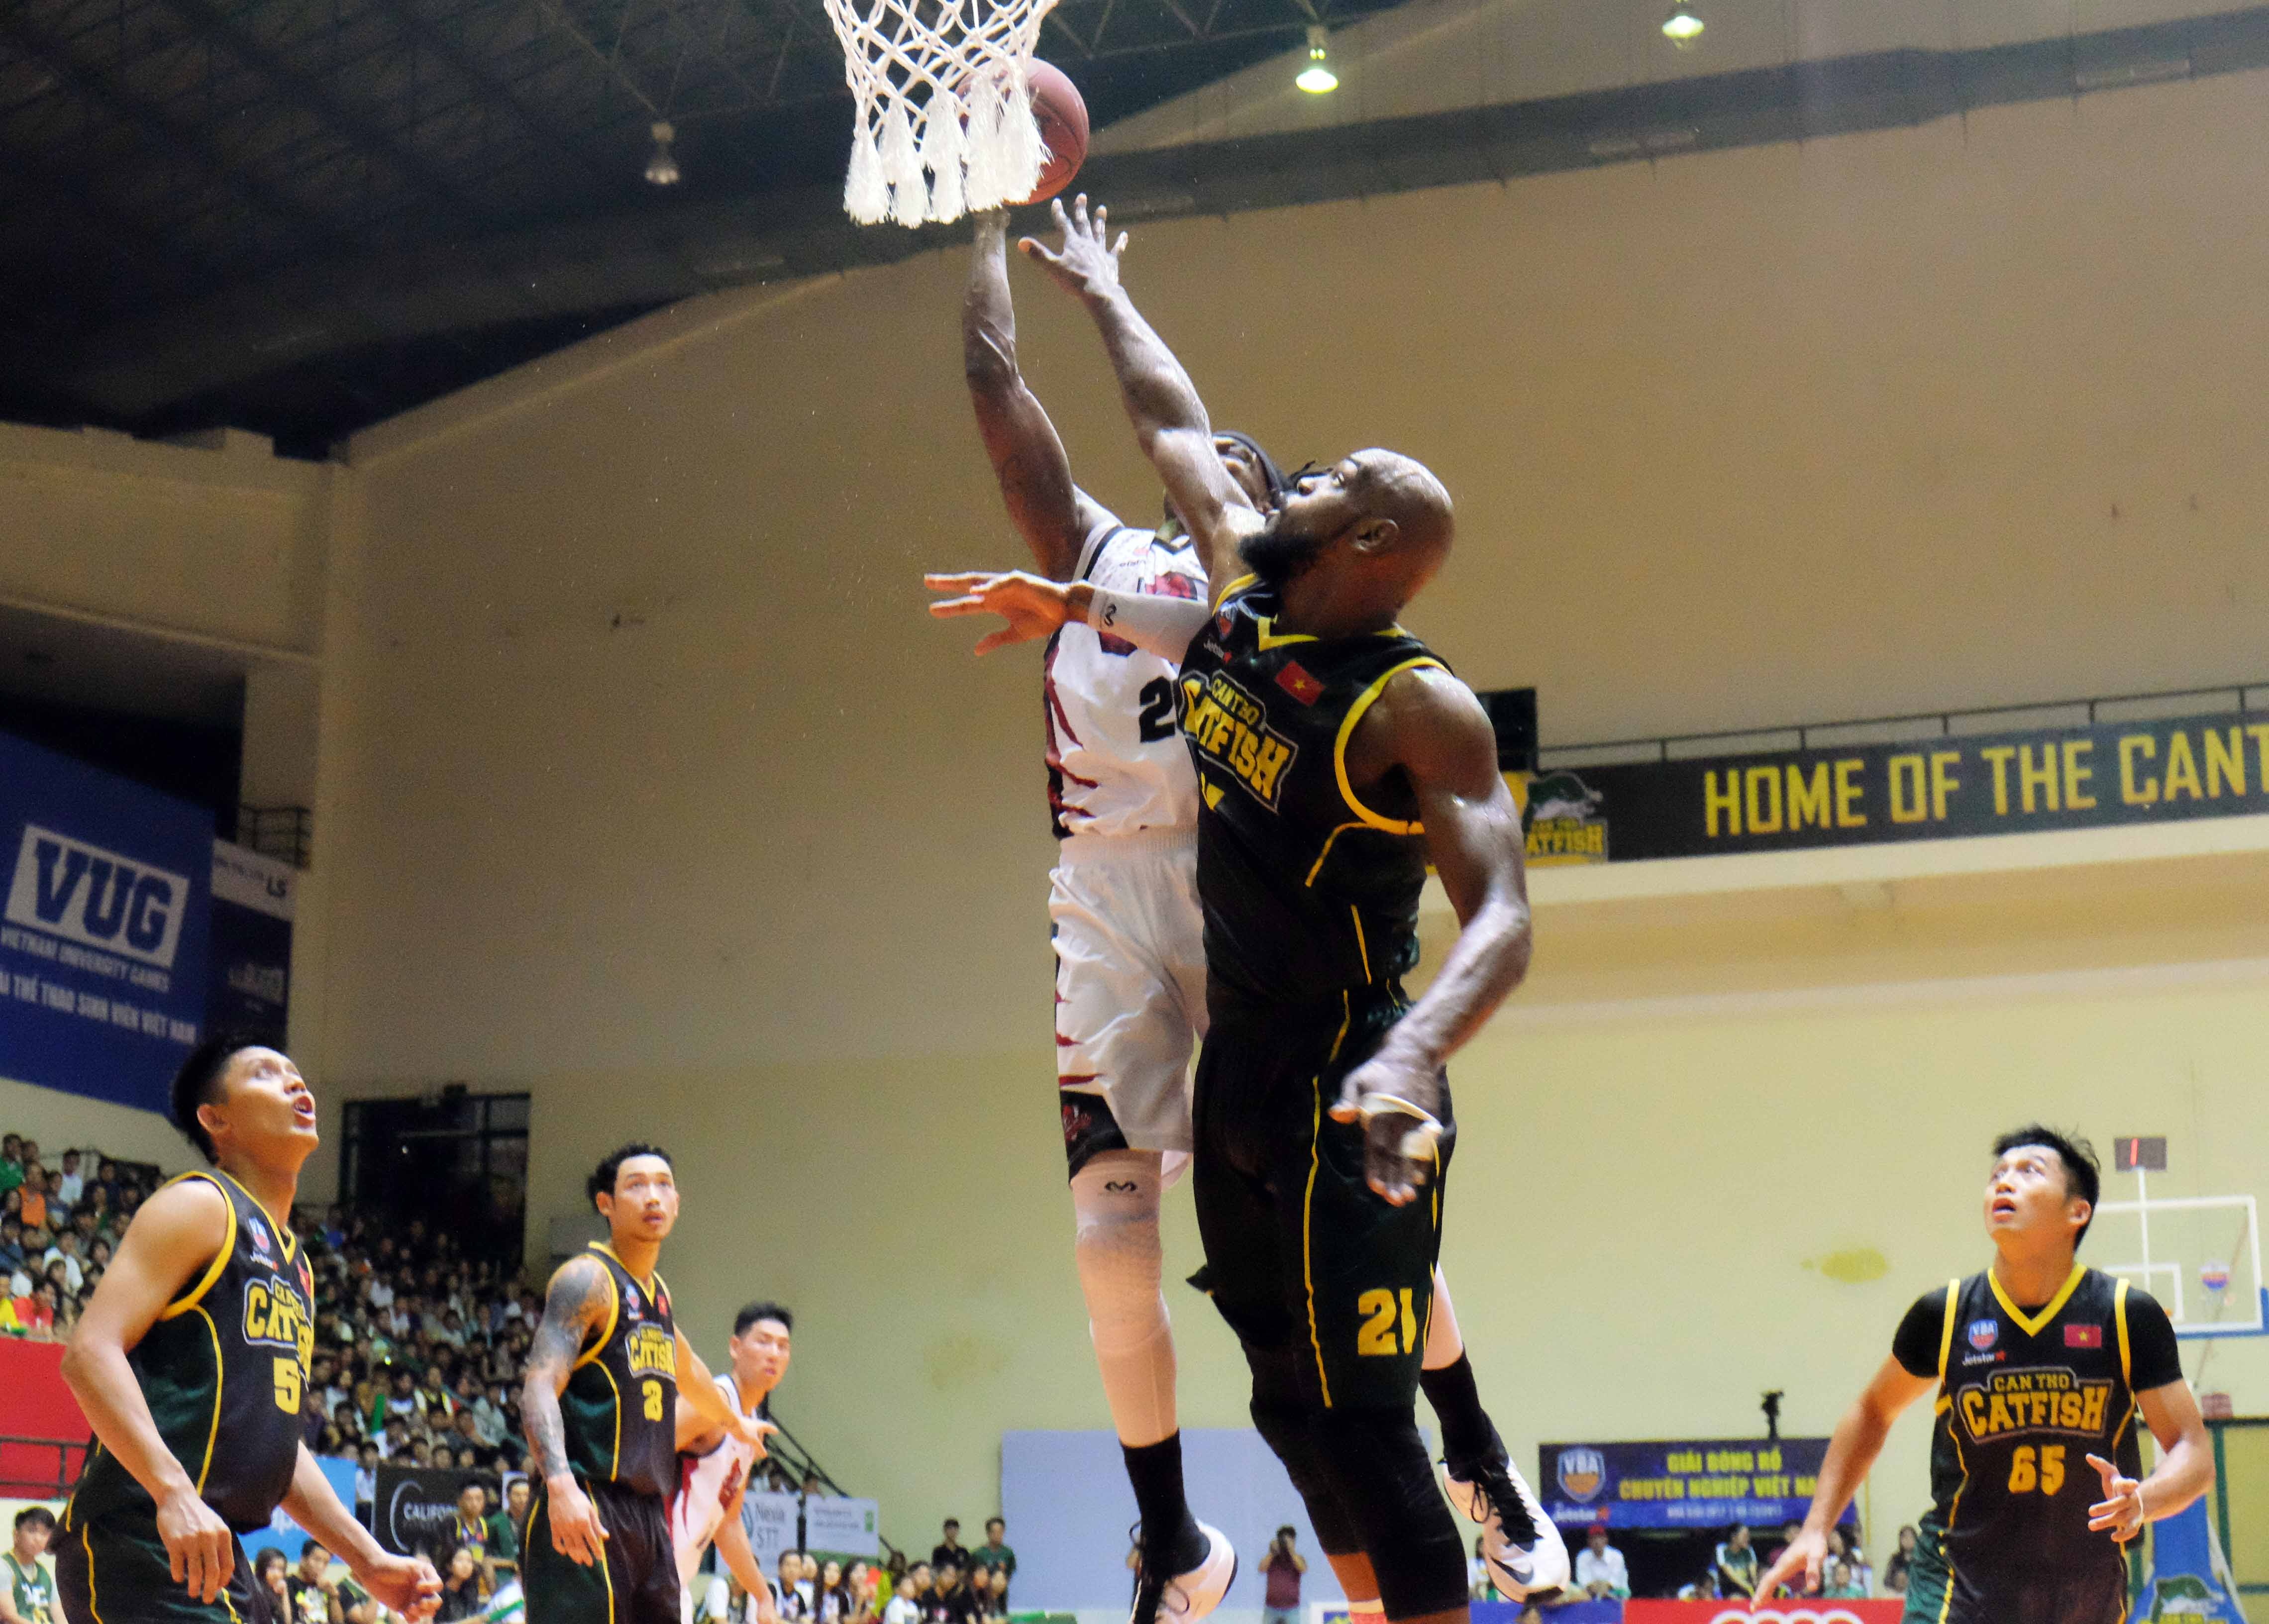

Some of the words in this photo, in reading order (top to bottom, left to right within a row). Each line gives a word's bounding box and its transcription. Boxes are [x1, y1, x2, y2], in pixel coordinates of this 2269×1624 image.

[1704, 759, 1866, 838] HOME
[1888, 751, 1961, 824] OF
[1981, 741, 2096, 816] THE
[35, 837, 173, 954] VUG
[1357, 1288, 1417, 1356] 21
[273, 1357, 301, 1415] 5
[1961, 1385, 2108, 1437] CATFISH
[1994, 1375, 2032, 1392] CAN
[2008, 1445, 2065, 1496] 65
